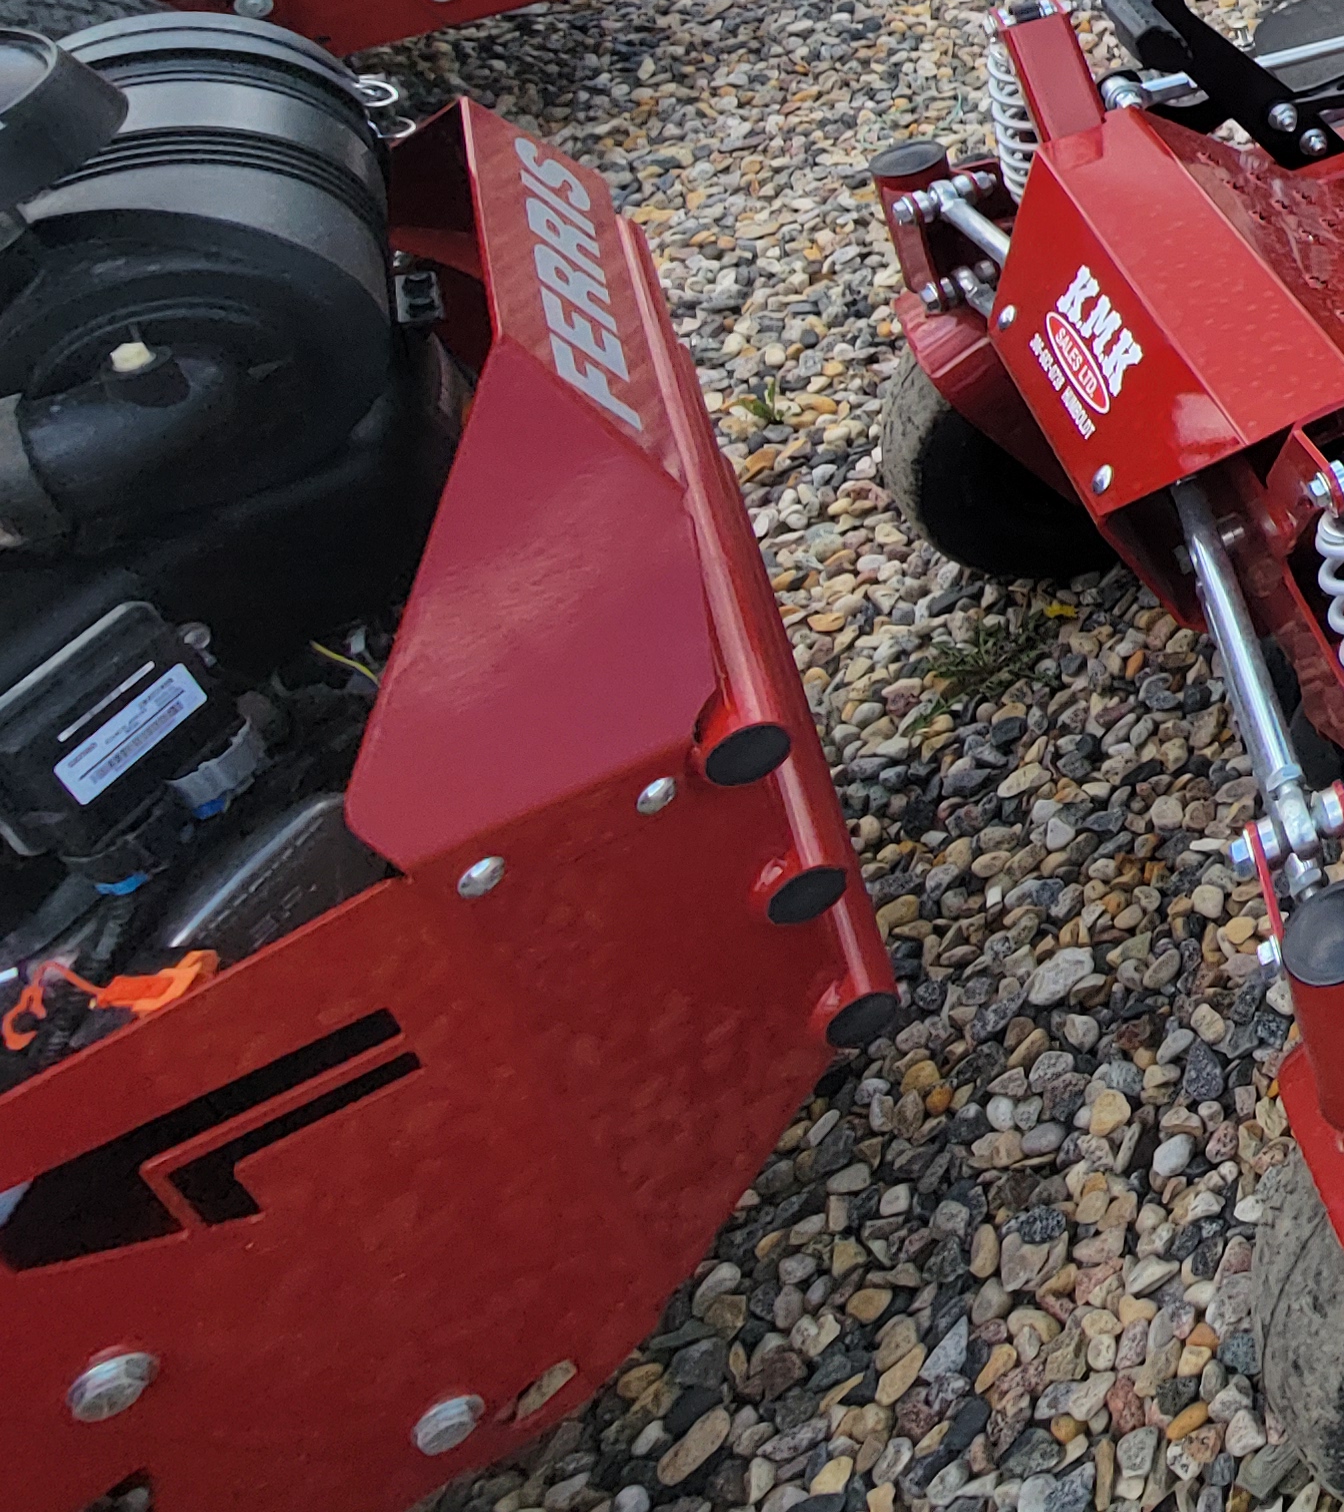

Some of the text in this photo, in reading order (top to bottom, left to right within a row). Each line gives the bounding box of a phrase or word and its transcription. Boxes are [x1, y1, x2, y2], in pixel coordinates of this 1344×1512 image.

[514, 137, 642, 432] FERRIS
[1055, 327, 1098, 399] SALES LTD.
